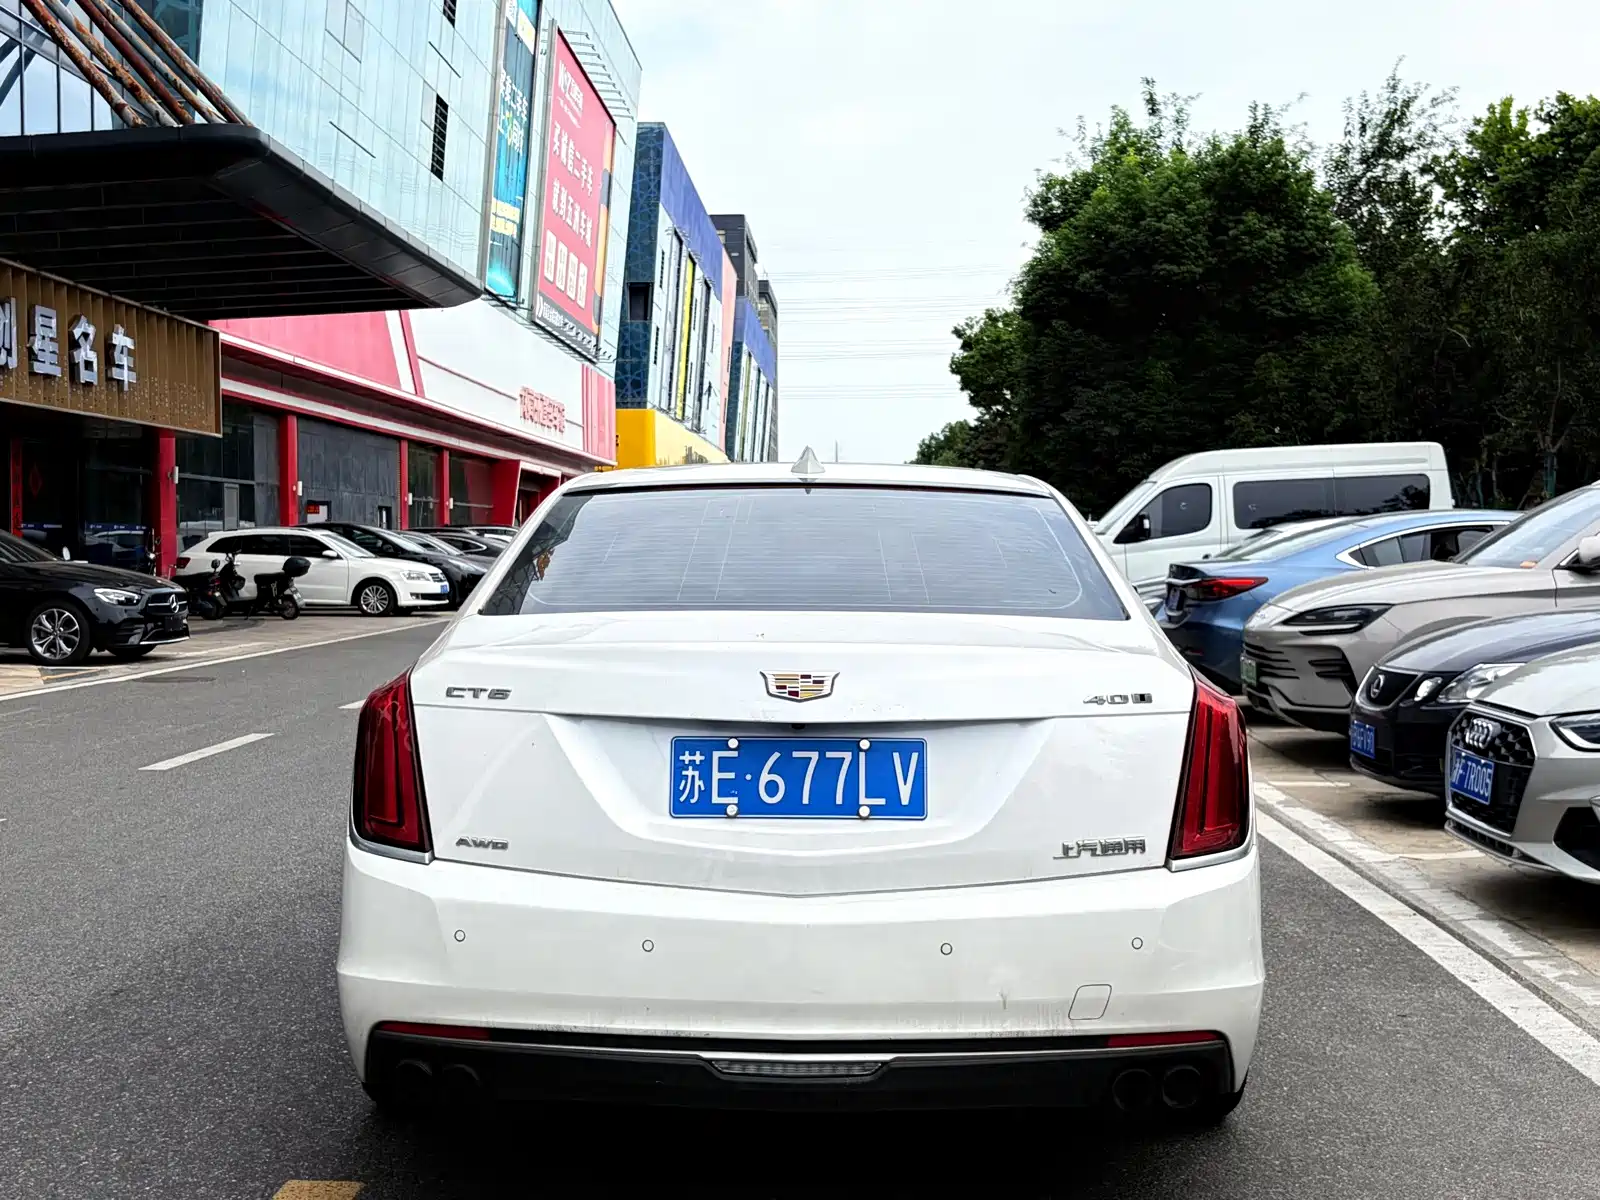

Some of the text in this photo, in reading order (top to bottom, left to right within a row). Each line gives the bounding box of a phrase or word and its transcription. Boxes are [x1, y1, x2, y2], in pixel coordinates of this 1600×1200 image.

[445, 686, 512, 700] CT6
[679, 750, 919, 806] 苏E·677LV
[455, 837, 508, 851] AWD
[1052, 837, 1146, 860] 上汽通用
